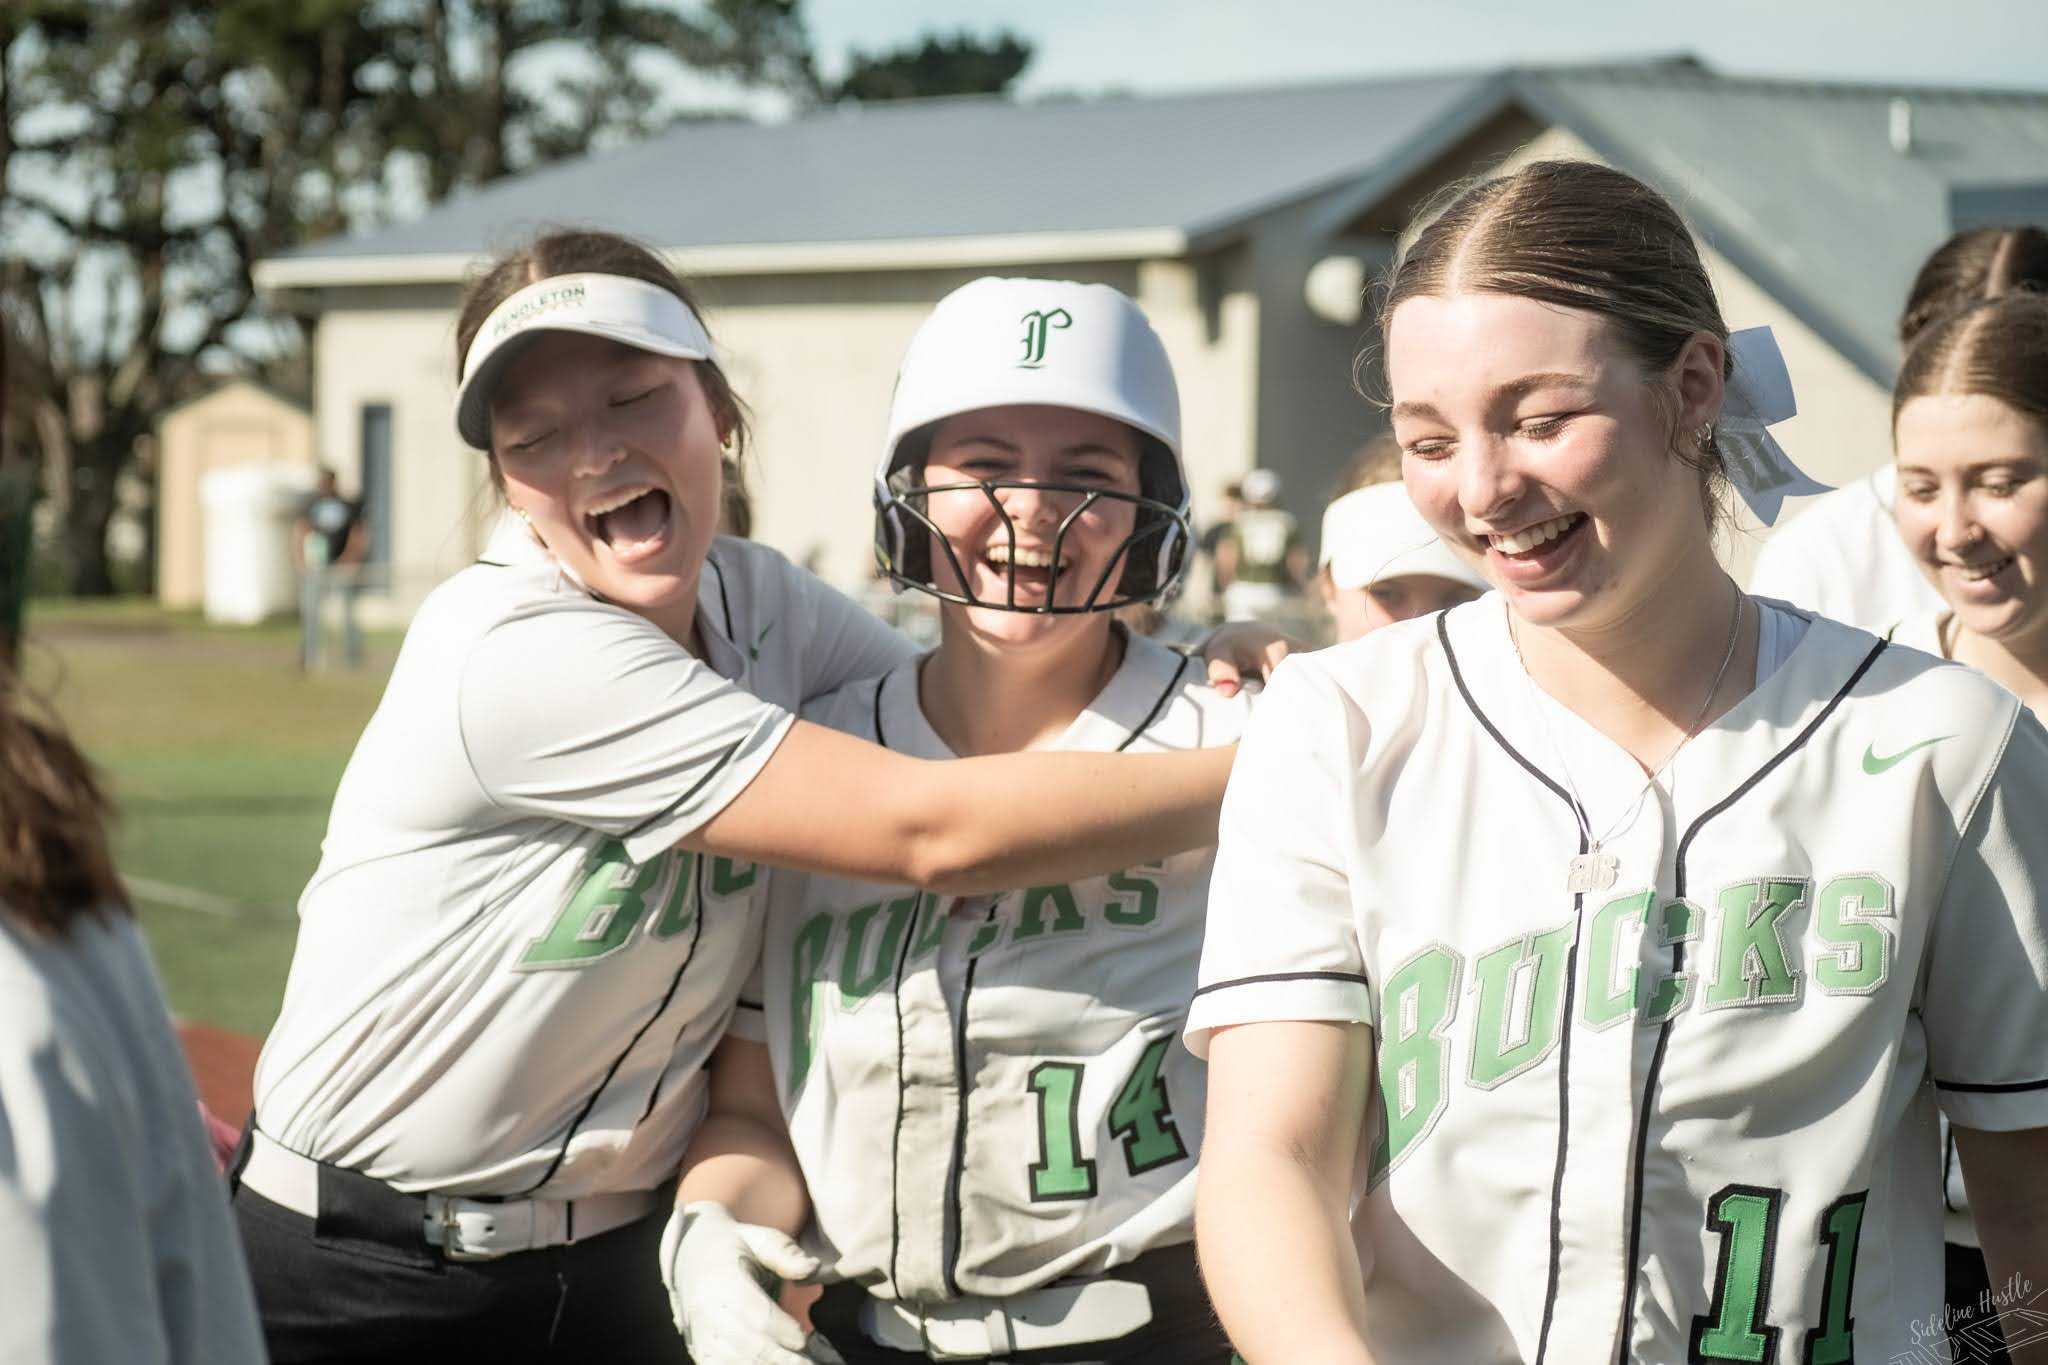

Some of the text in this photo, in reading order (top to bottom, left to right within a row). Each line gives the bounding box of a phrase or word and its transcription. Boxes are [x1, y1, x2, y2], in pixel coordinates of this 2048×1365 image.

[1026, 1030, 1190, 1203] 14
[1367, 871, 1896, 1194] BUCKS
[1688, 1183, 1870, 1365] 11
